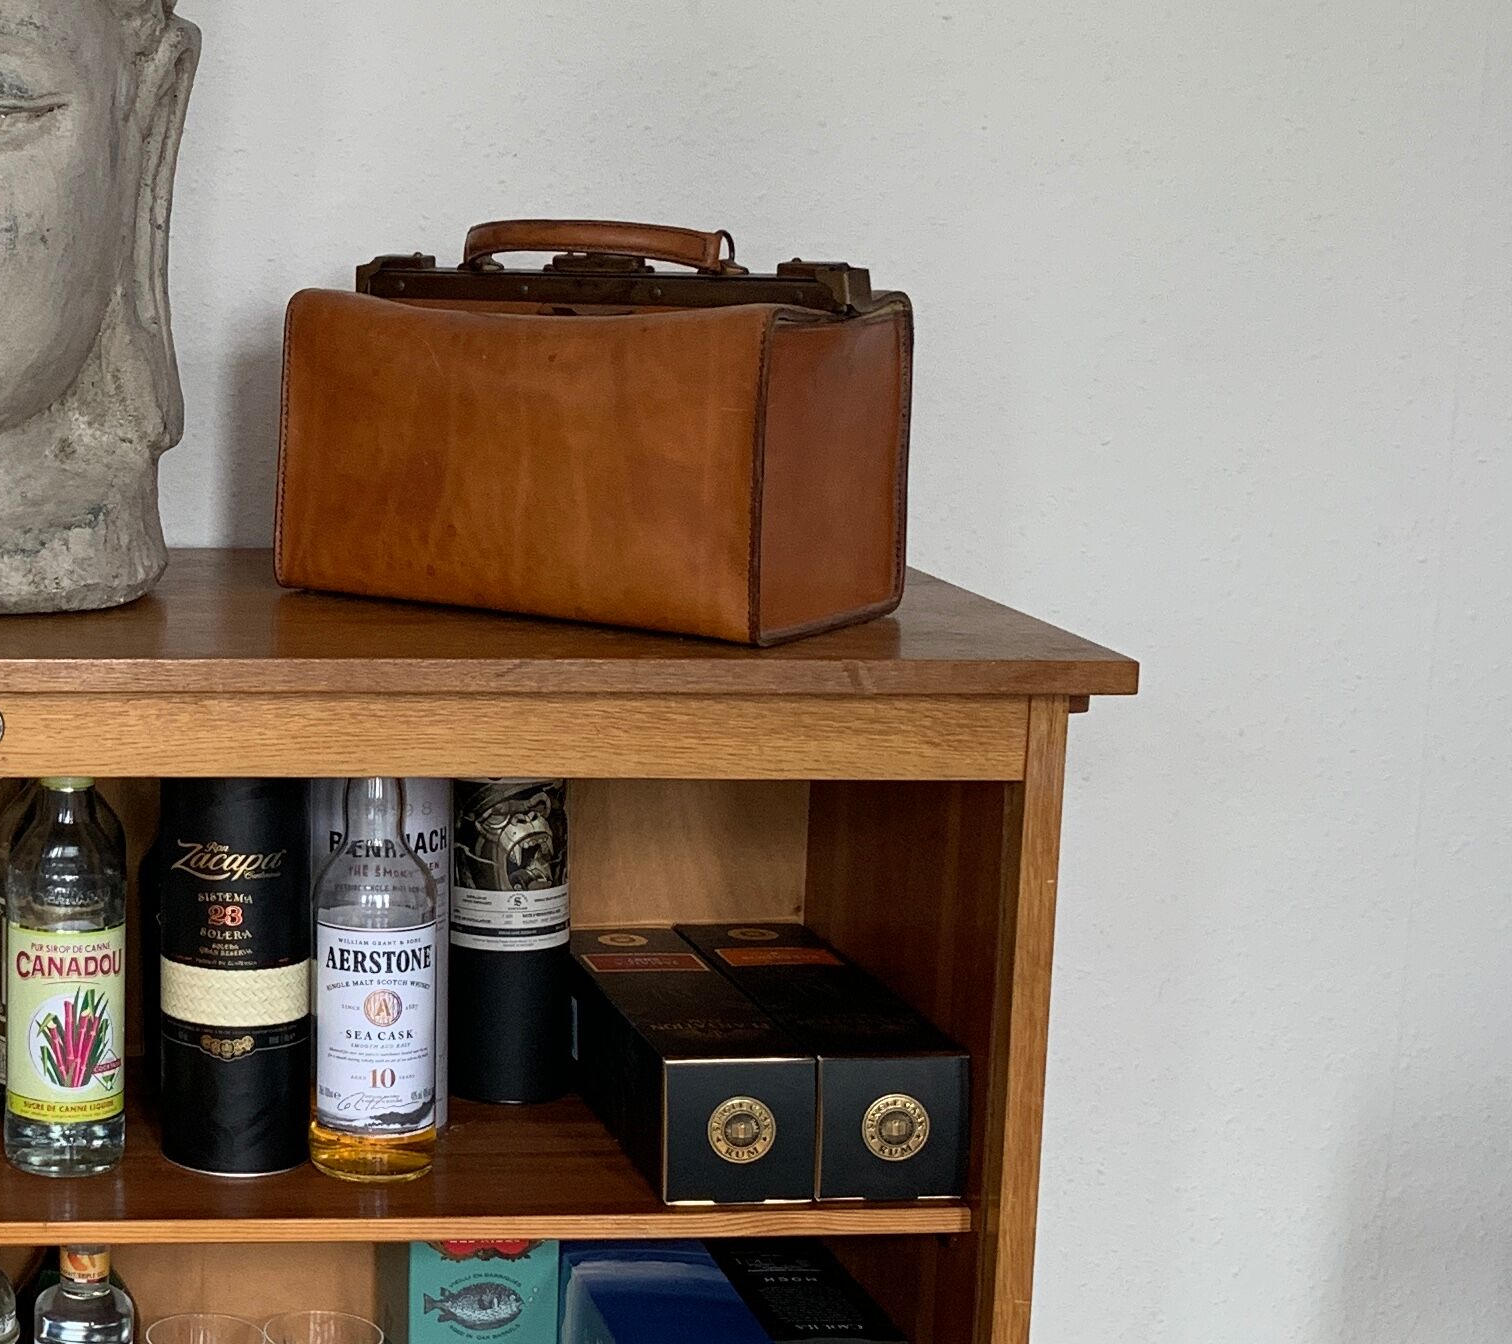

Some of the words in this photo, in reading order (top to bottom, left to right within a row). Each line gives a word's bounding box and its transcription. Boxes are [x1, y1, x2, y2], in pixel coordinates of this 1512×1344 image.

[170, 838, 287, 881] Zacapa
[197, 892, 253, 904] SISTEMA
[208, 905, 243, 926] 23
[199, 927, 252, 941] SOLERA
[46, 944, 70, 953] SIROP
[72, 945, 82, 953] DE
[85, 941, 111, 952] CANNE
[338, 937, 369, 945] WILLIAM
[16, 949, 122, 978] CANADOU
[326, 944, 432, 974] AERSTONE
[352, 979, 374, 987] MALT
[345, 1029, 372, 1041] SEA
[378, 1029, 414, 1041] CASK
[368, 1068, 396, 1089] 10
[24, 1101, 45, 1111] SUCRE
[59, 1104, 87, 1112] CANNE
